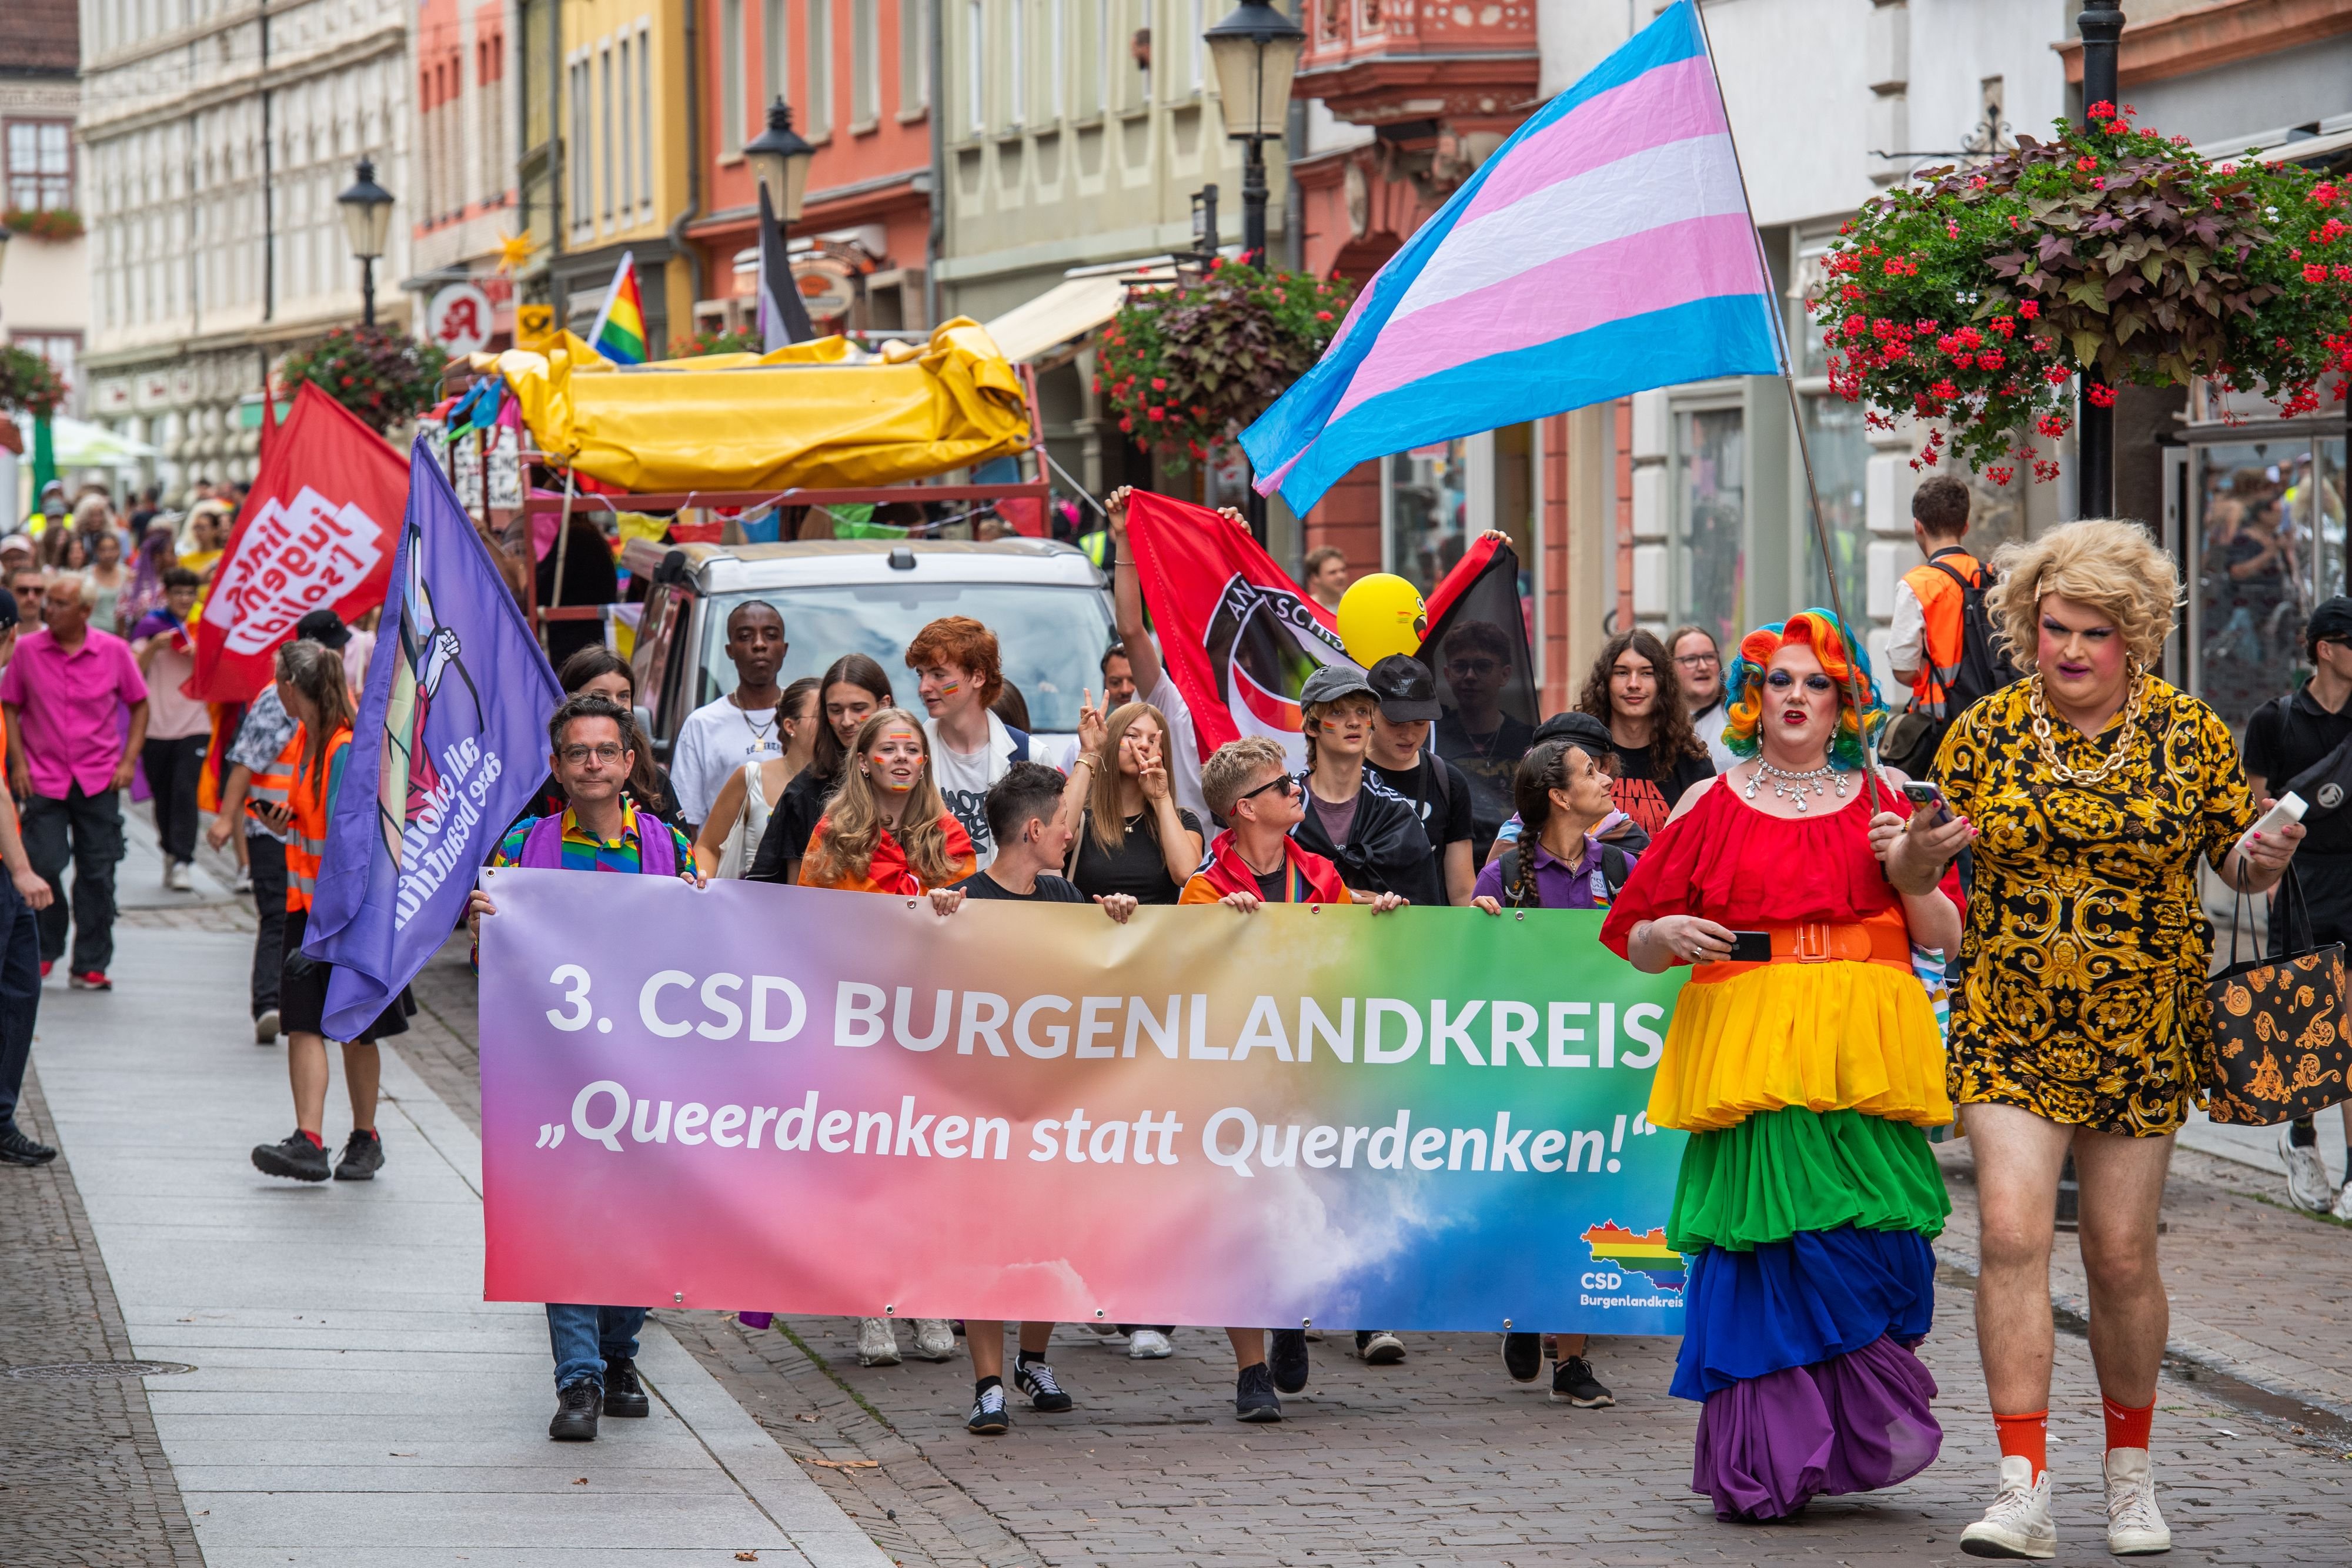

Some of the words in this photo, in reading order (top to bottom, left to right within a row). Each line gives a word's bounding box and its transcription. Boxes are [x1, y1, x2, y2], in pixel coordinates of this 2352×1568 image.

[546, 964, 613, 1034] 3.
[639, 969, 807, 1043] CSD
[833, 980, 1665, 1069] BURGENLANDKREIS
[535, 1079, 1011, 1160] „Queerdenken
[1028, 1108, 1184, 1165] statt
[1580, 1294, 1683, 1309] Burgenlandkreis
[1581, 1272, 1622, 1290] CSD
